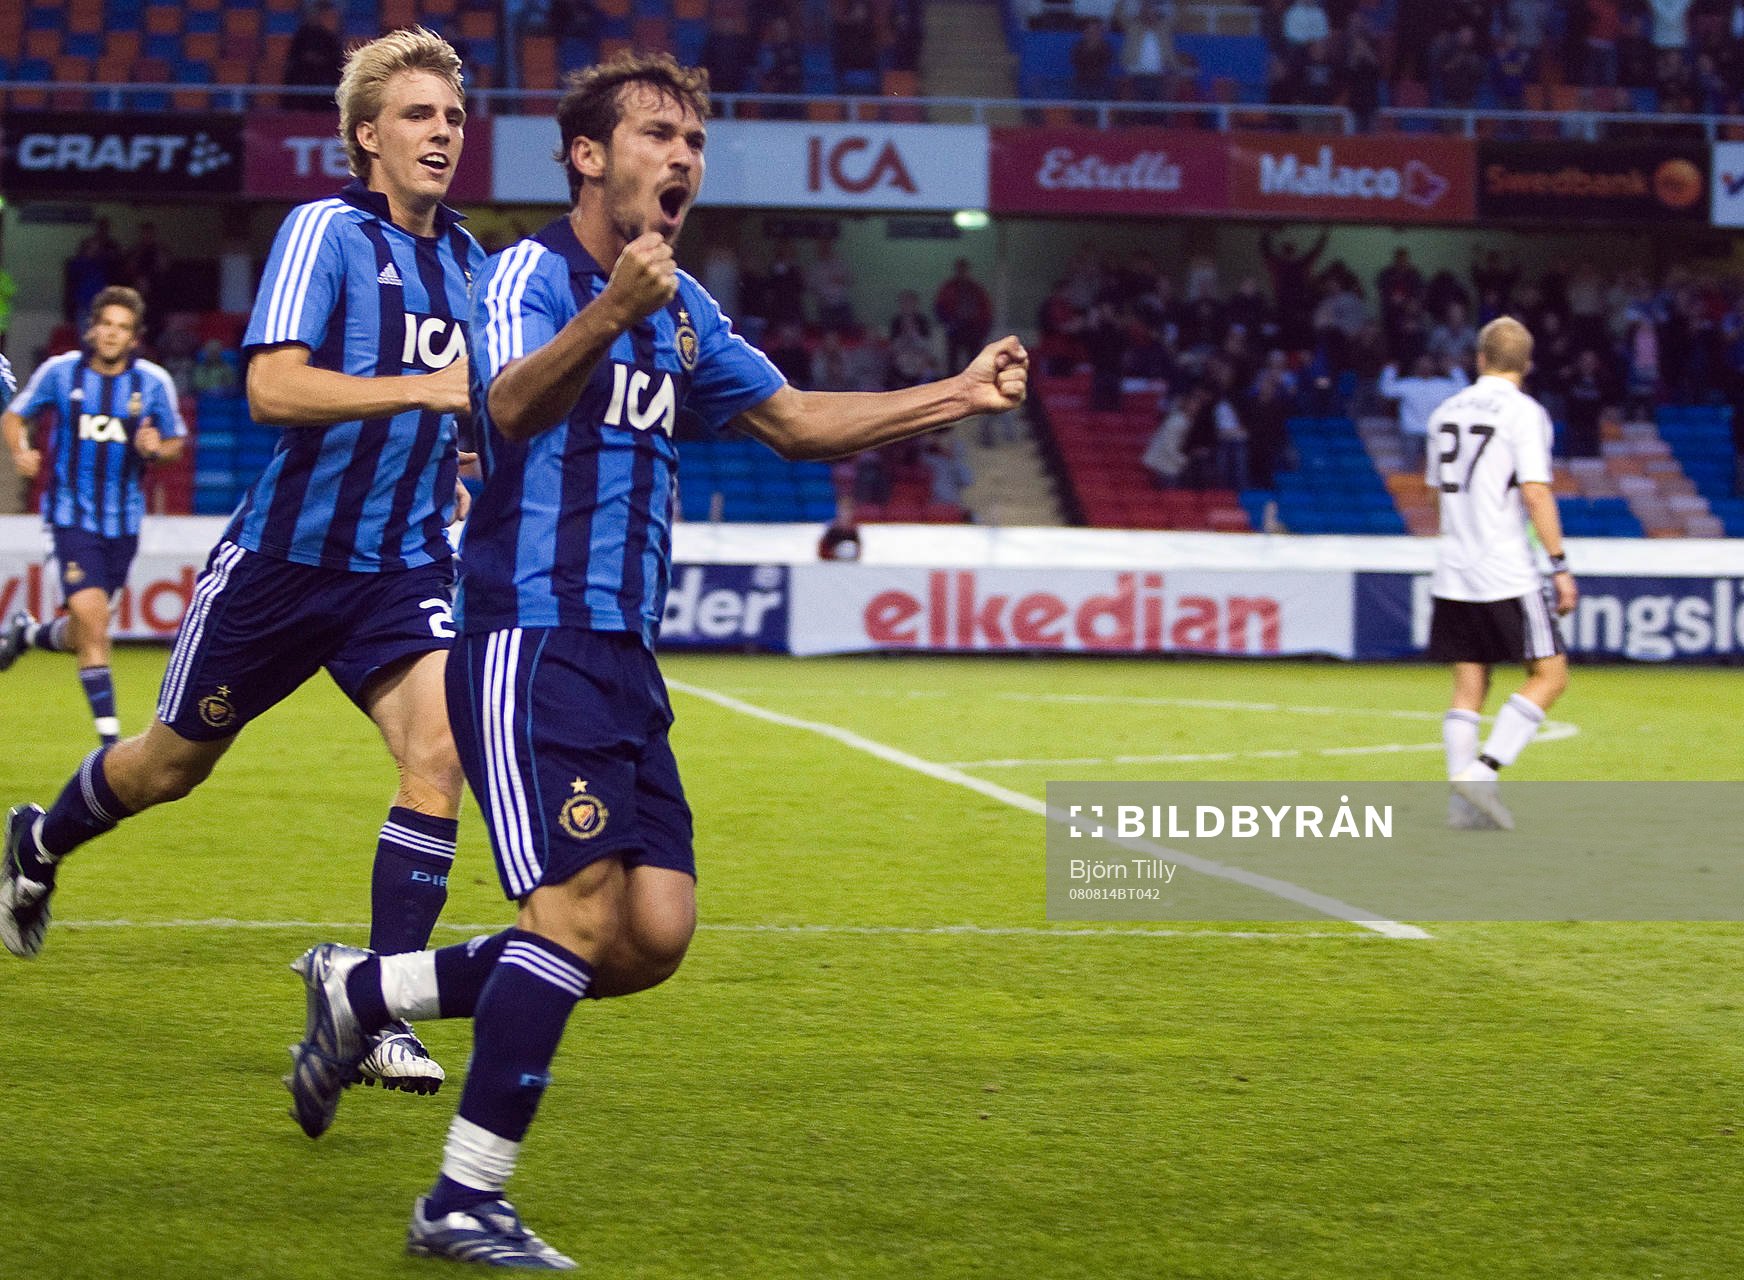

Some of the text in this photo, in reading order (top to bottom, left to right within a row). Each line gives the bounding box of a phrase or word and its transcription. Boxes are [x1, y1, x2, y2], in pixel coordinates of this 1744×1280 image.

[17, 134, 186, 171] CRAFT
[283, 136, 350, 178] TE
[808, 135, 918, 194] ICA
[1259, 144, 1401, 198] Malaco
[79, 413, 128, 443] ICA
[603, 363, 676, 438] ICA
[1439, 422, 1496, 493] 27
[659, 567, 782, 638] der
[862, 570, 1281, 651] elkedian
